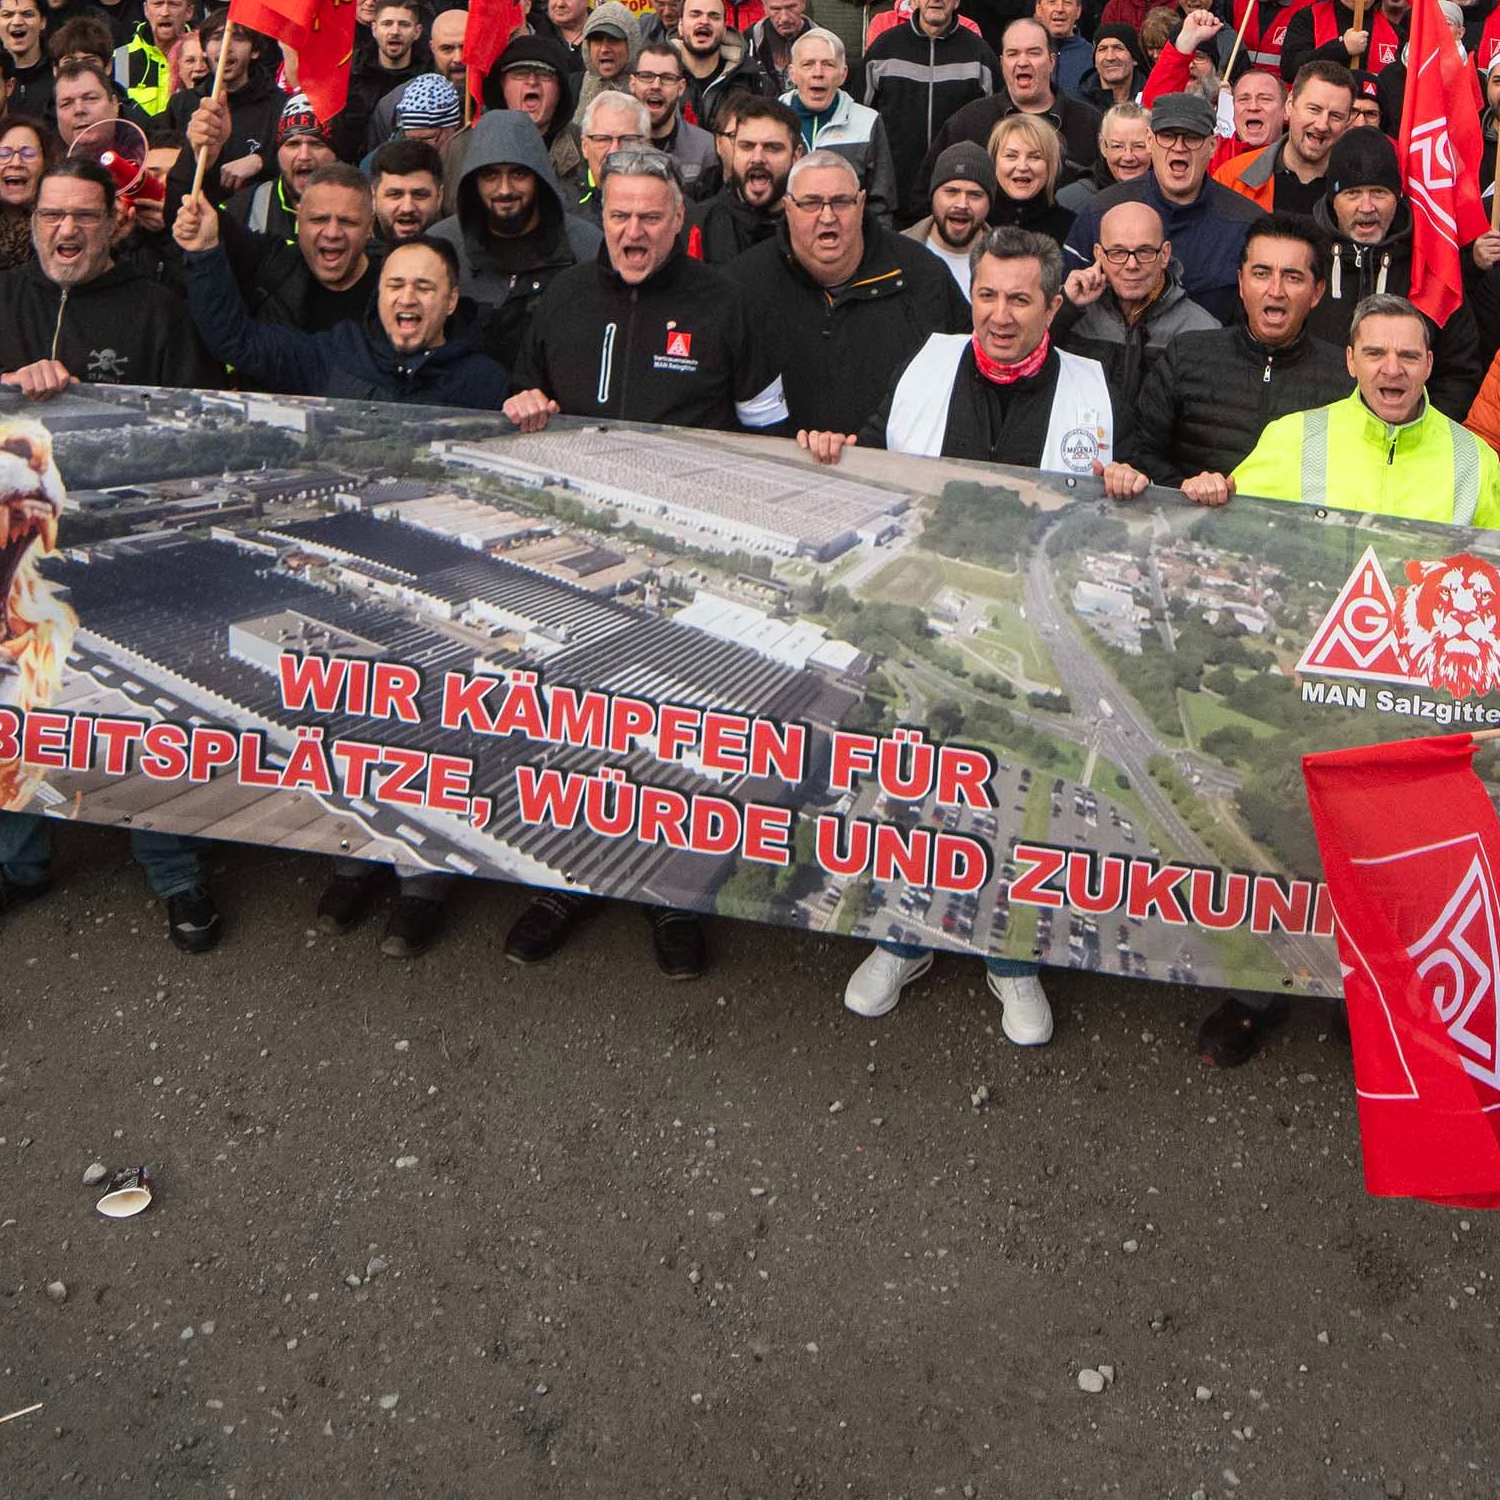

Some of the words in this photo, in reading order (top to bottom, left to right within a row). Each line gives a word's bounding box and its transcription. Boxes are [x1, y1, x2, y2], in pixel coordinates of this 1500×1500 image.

[276, 652, 421, 723] WIR
[440, 670, 807, 783] KÄMPFEN
[829, 728, 996, 812] FÜR
[1301, 681, 1367, 709] MAN
[515, 763, 794, 866] WÜRDE
[815, 813, 988, 894] UND
